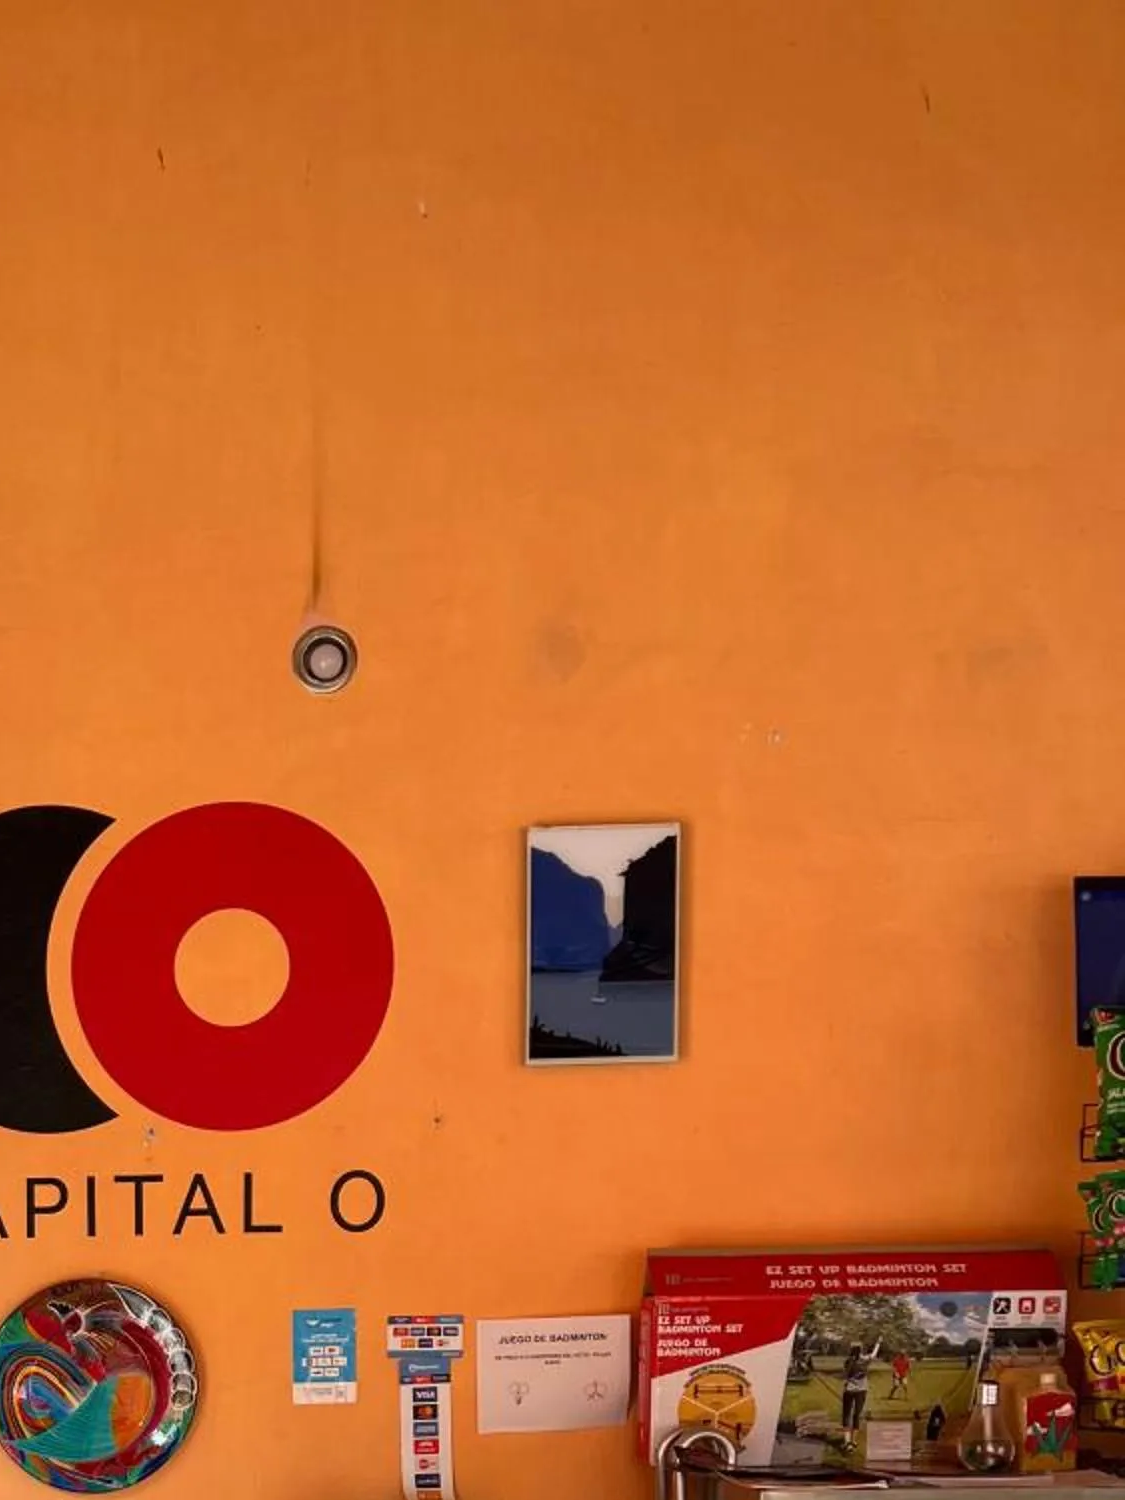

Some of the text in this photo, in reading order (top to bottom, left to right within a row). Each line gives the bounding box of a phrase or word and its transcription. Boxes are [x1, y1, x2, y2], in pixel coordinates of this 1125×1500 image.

[329, 1169, 386, 1233] O
[788, 1265, 814, 1275] SET
[819, 1265, 840, 1275] UP
[846, 1263, 937, 1274] BADMINTON
[942, 1263, 967, 1273] SET
[770, 1277, 939, 1289] JUEGO DE BADMINTON
[674, 1315, 692, 1324] SET
[696, 1315, 711, 1324] UP
[657, 1323, 744, 1334] BADMINTON SET
[657, 1338, 690, 1347] JUEGO
[657, 1347, 721, 1357] BADMINTON
